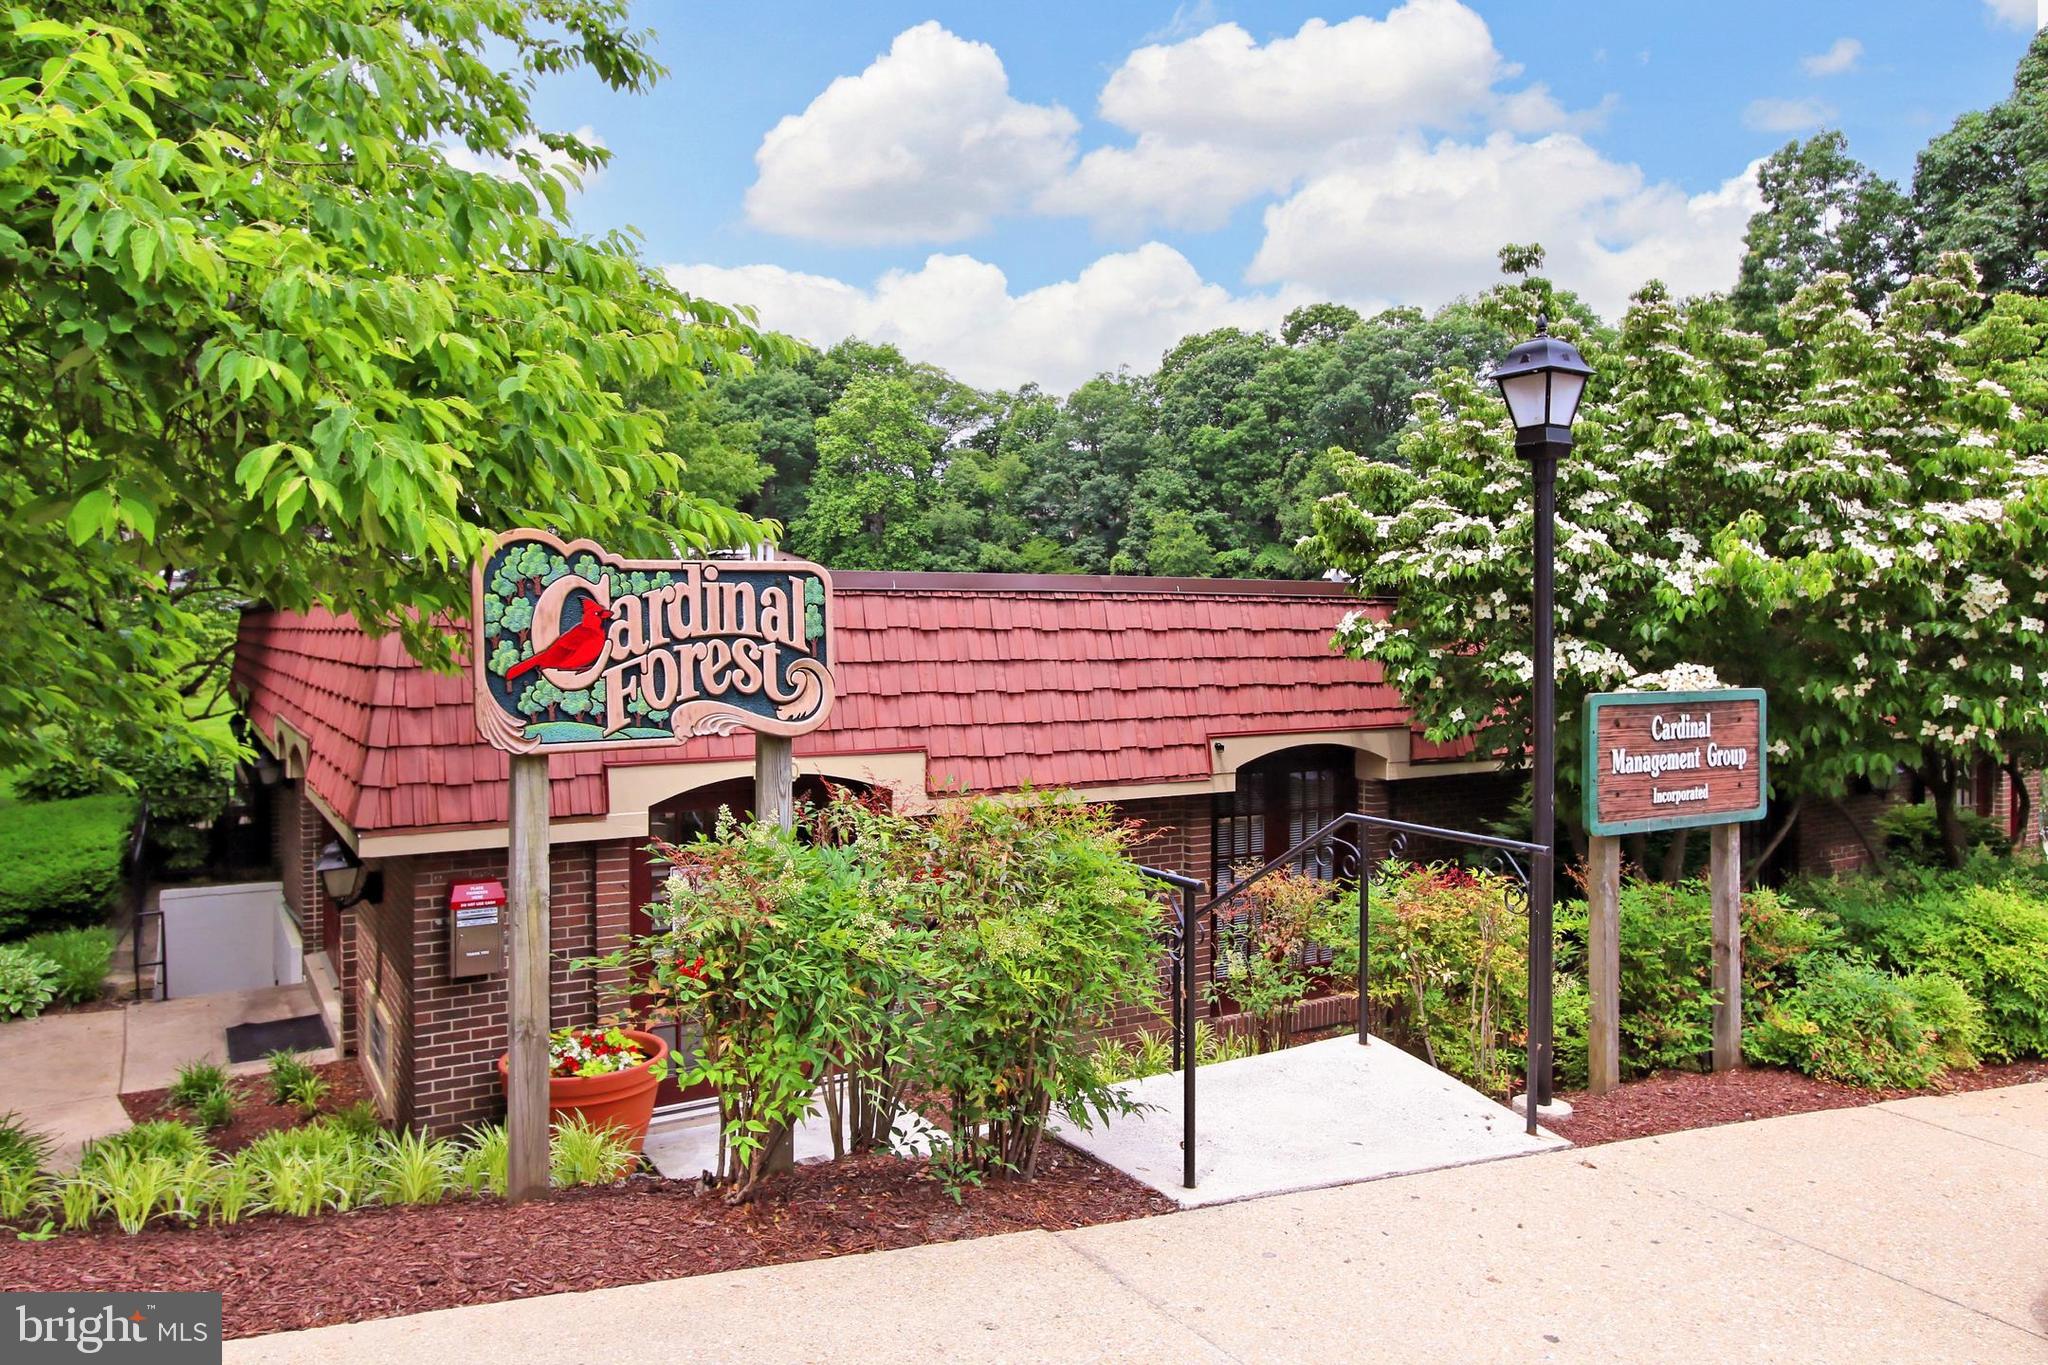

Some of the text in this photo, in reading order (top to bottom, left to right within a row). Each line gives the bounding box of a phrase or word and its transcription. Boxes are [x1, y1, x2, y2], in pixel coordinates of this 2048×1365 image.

[531, 563, 810, 691] Cardinal
[601, 638, 814, 737] Forest
[1651, 712, 1712, 741] Cardinal
[1611, 742, 1748, 778] Management Group
[1653, 783, 1709, 805] Incorporated
